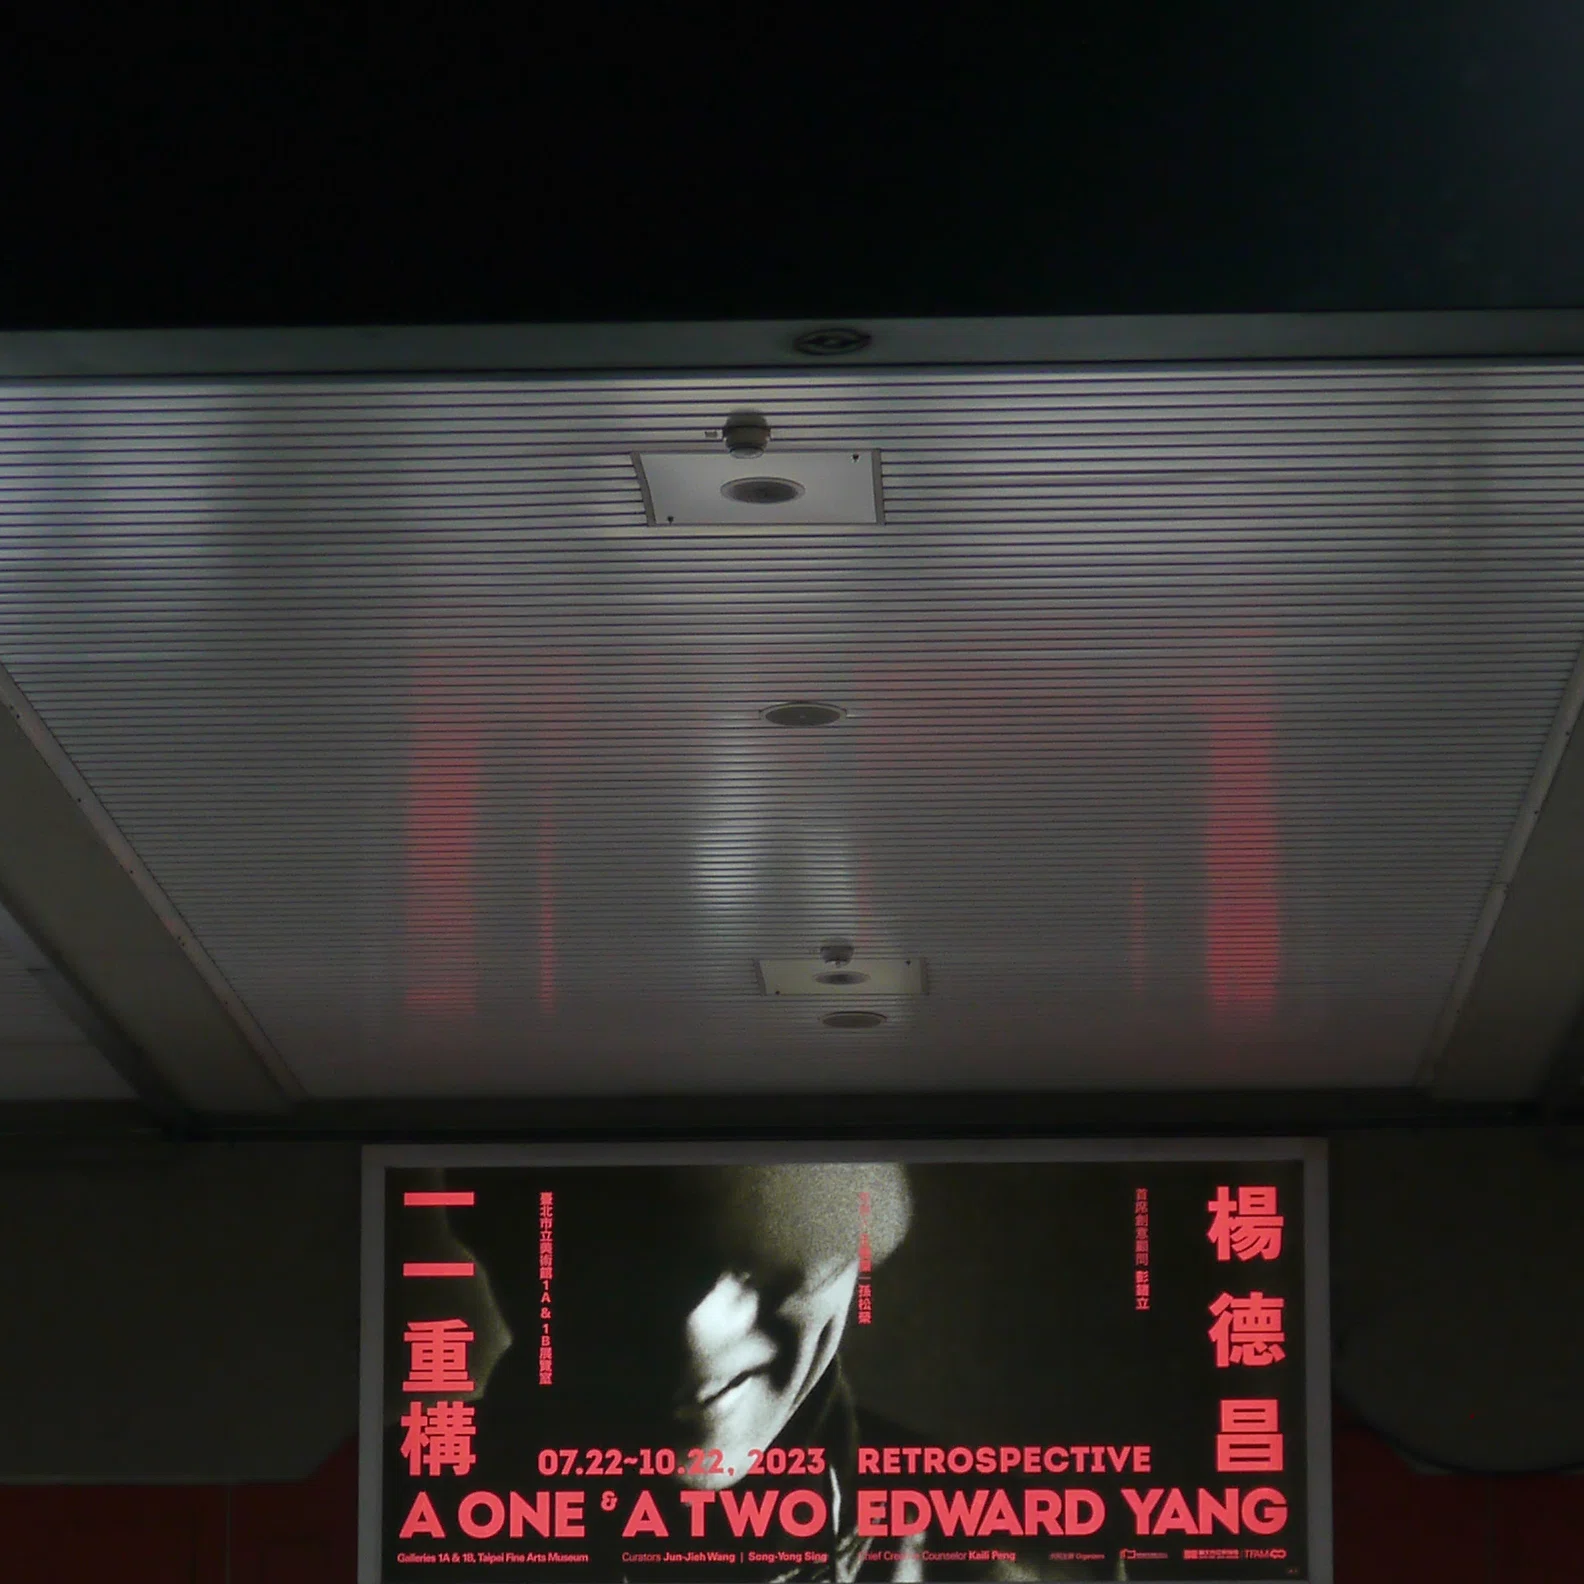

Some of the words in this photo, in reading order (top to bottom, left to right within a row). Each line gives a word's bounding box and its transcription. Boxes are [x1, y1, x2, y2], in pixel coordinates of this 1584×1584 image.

[401, 1191, 476, 1477] 一一重構
[1206, 1185, 1286, 1473] 楊德昌
[747, 1447, 827, 1475] 2023
[858, 1445, 1152, 1475] RETROSPECTIVE
[399, 1491, 446, 1539] A
[457, 1490, 586, 1539] ONE
[600, 1491, 618, 1512] &
[622, 1490, 669, 1538] A
[680, 1489, 829, 1538] TWO
[857, 1487, 1107, 1537] EDWARD
[1120, 1486, 1289, 1536] YANG
[397, 1552, 436, 1563] Galleries
[438, 1552, 450, 1563] 1A
[451, 1552, 461, 1563] &
[478, 1552, 504, 1565] Taipei
[505, 1552, 525, 1563] Fine
[526, 1552, 546, 1563] Arts
[547, 1552, 589, 1563] Museum
[621, 1552, 661, 1562] Curators
[663, 1552, 706, 1562] Jun-Jieh
[707, 1552, 736, 1564] Wang
[748, 1552, 803, 1564] Song-Yong
[804, 1551, 828, 1564] Sing
[922, 1550, 967, 1561] Counselor
[991, 1550, 1017, 1563] Peng
